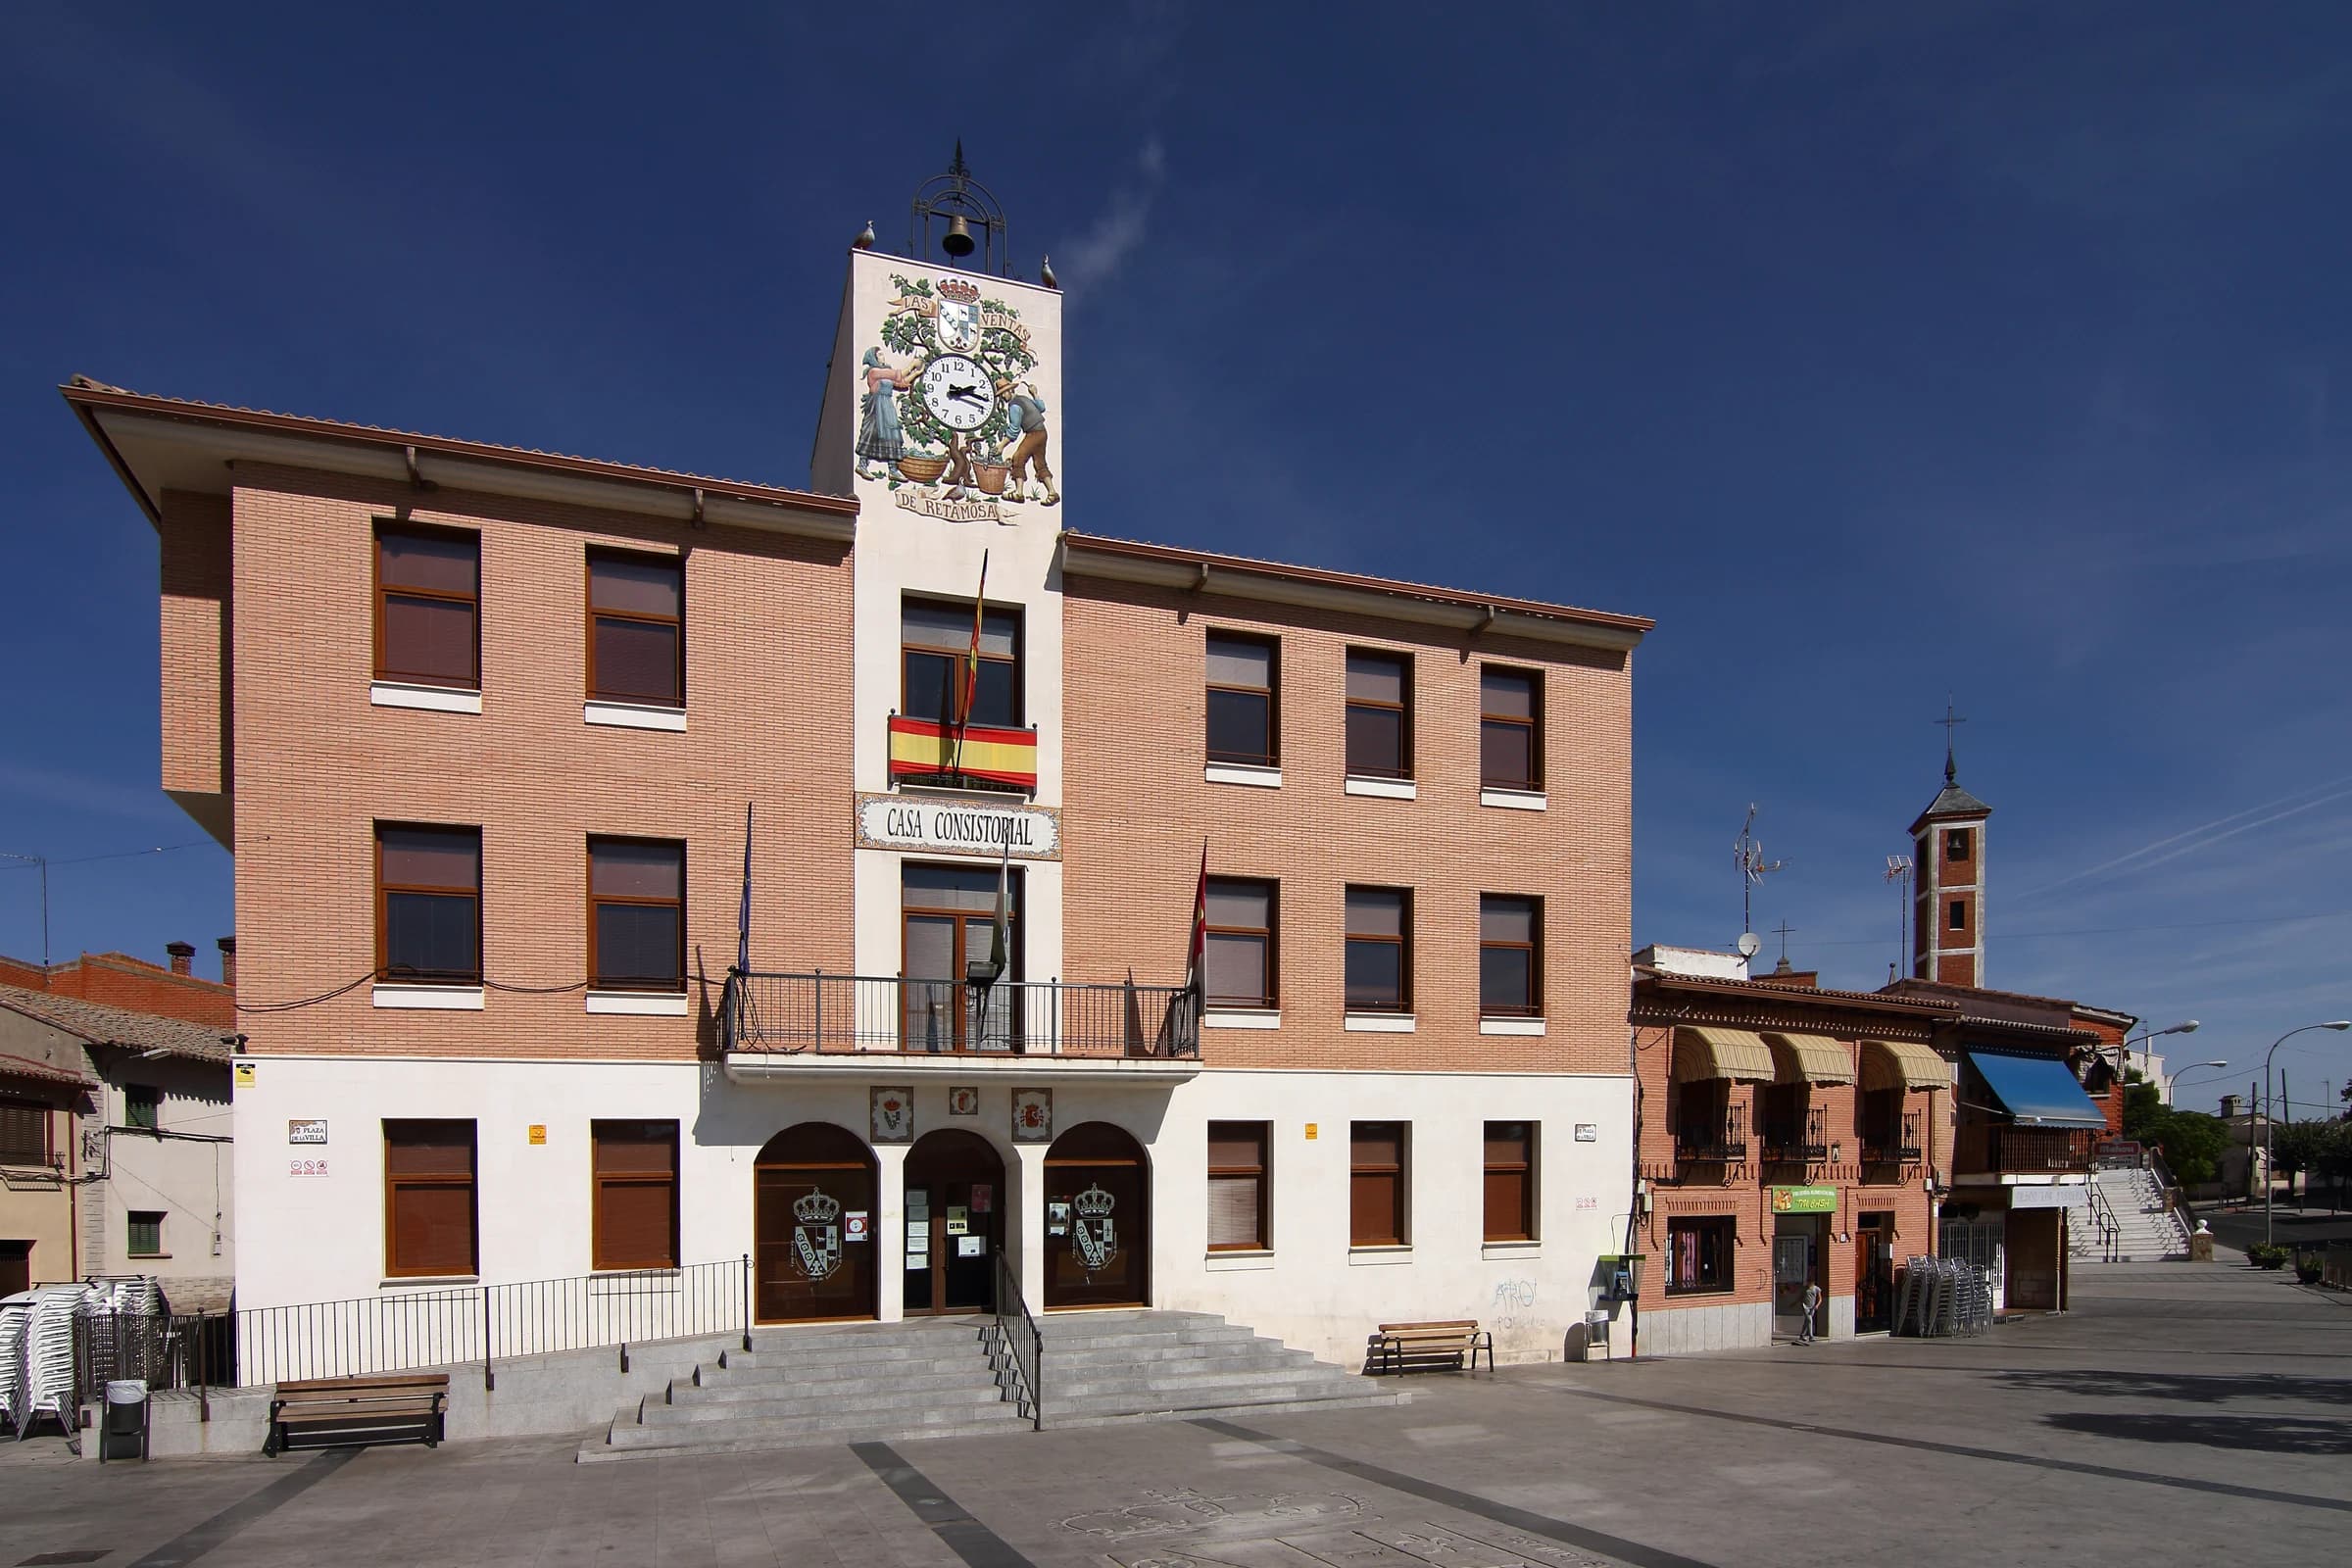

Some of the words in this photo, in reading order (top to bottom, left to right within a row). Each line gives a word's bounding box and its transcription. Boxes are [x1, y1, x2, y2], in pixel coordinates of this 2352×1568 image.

[905, 297, 928, 310] LAS
[981, 314, 1028, 341] VENTAS
[941, 363, 950, 373] 11
[954, 361, 965, 371] 12
[932, 371, 942, 382] 10
[970, 368, 975, 377] 1
[927, 383, 934, 393] 9
[979, 379, 986, 389] 2
[932, 397, 939, 407] 8
[942, 409, 950, 418] 7
[969, 414, 976, 423] 5
[955, 415, 962, 424] 6
[902, 493, 917, 508] DE
[925, 500, 997, 519] RETAMOSA
[887, 808, 922, 838] CASA
[935, 811, 1033, 845] CONSISTORIAL
